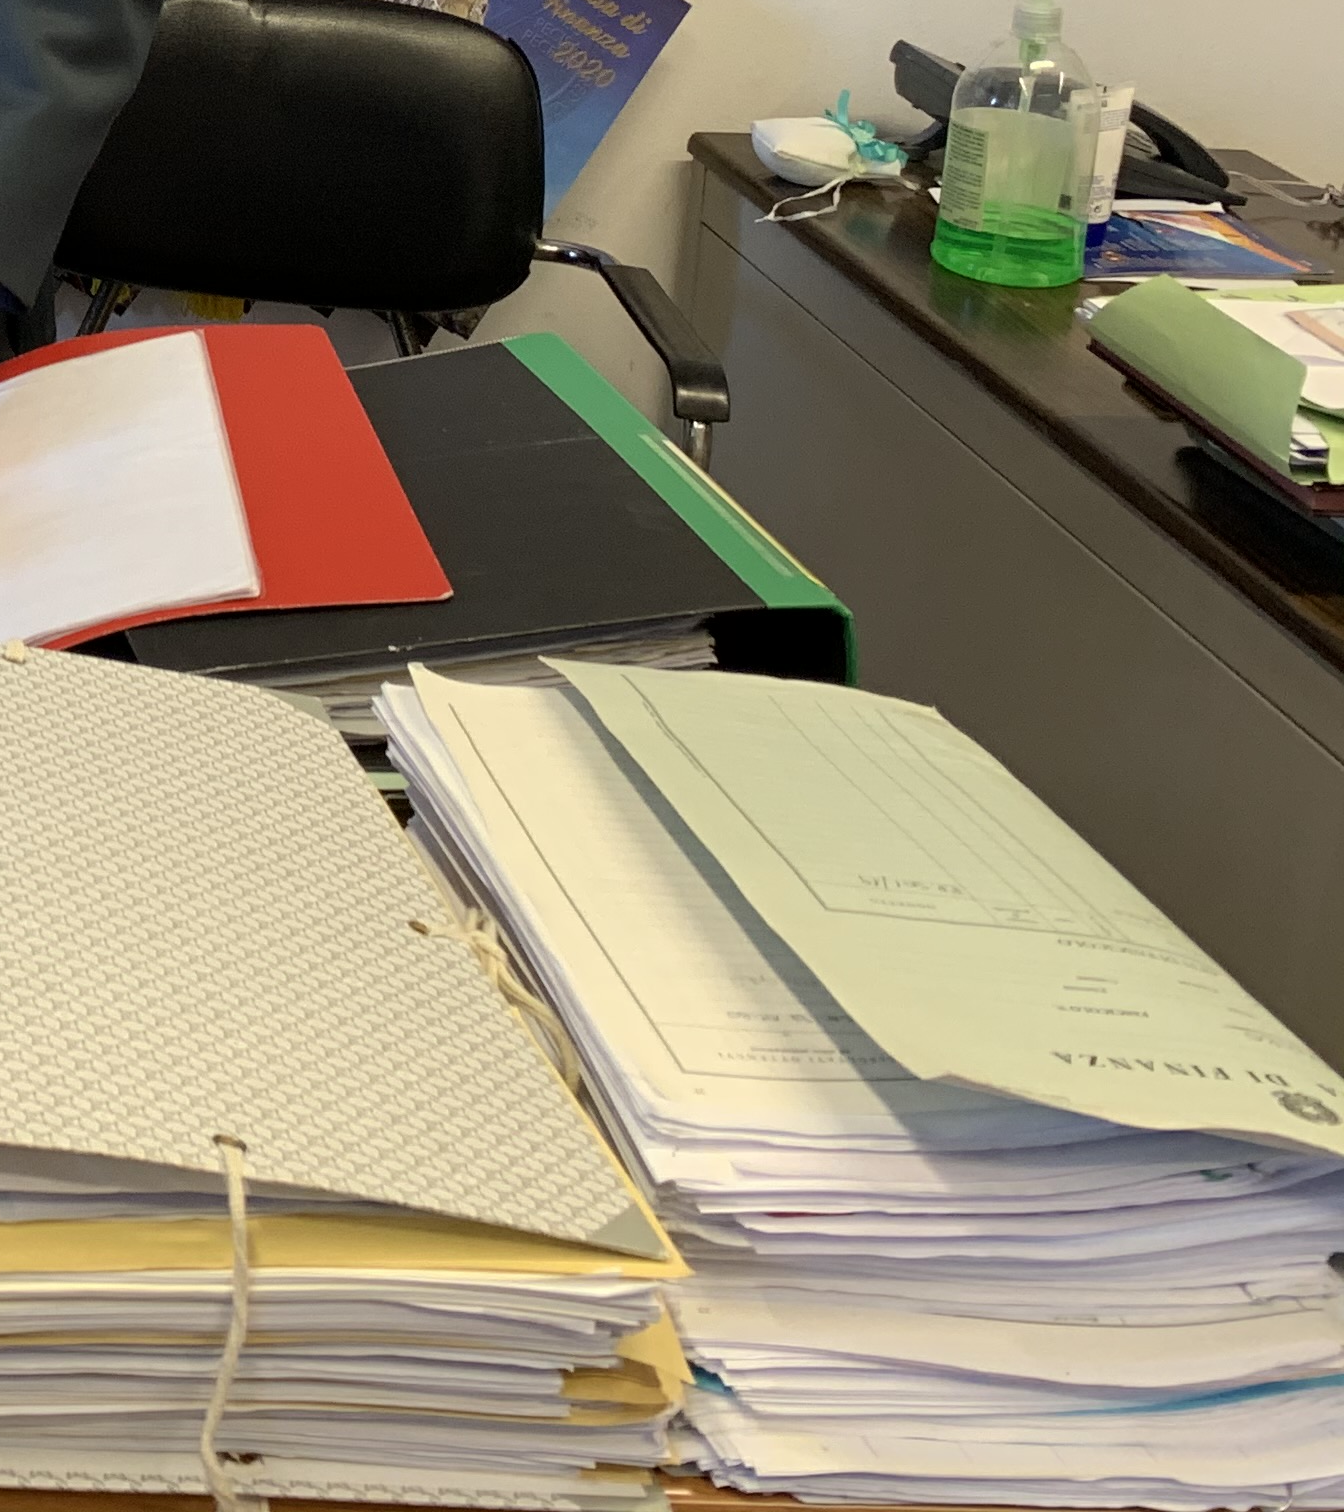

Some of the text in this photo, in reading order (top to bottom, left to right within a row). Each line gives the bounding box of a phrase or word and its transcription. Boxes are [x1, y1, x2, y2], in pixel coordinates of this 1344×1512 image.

[620, 11, 653, 35] di
[552, 40, 615, 88] 2020
[1048, 1050, 1290, 1088] DI FINANZA
